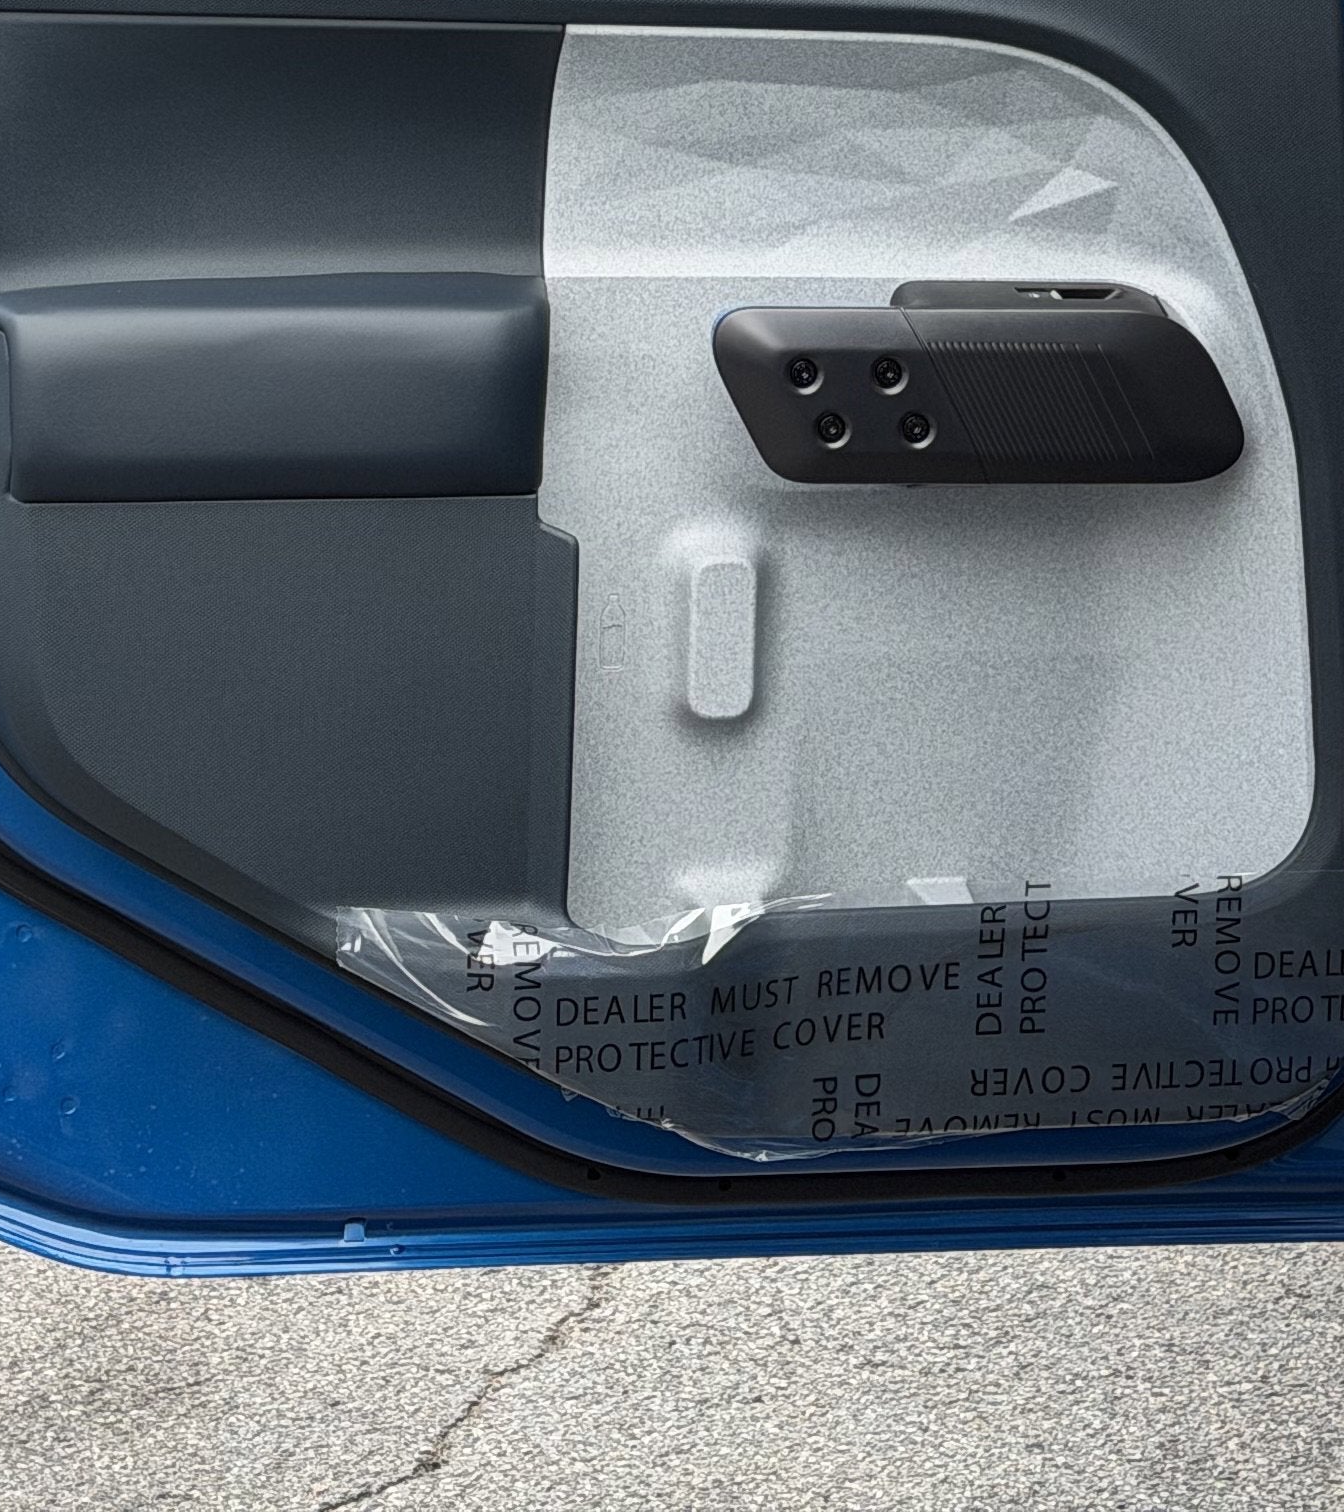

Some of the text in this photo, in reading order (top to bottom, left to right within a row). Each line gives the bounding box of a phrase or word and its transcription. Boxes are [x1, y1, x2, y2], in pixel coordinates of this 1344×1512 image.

[975, 903, 1007, 1035] DEALER
[1019, 880, 1052, 1034] PROTECT
[1213, 874, 1243, 1027] REMOVE
[556, 961, 961, 1027] DEALER MUST REMOVE
[555, 1011, 886, 1074] PROTECTIVE COVER
[1111, 1055, 1312, 1090] PROTECTIVE
[811, 1076, 838, 1143] PRO
[969, 1064, 1091, 1097] COVER
